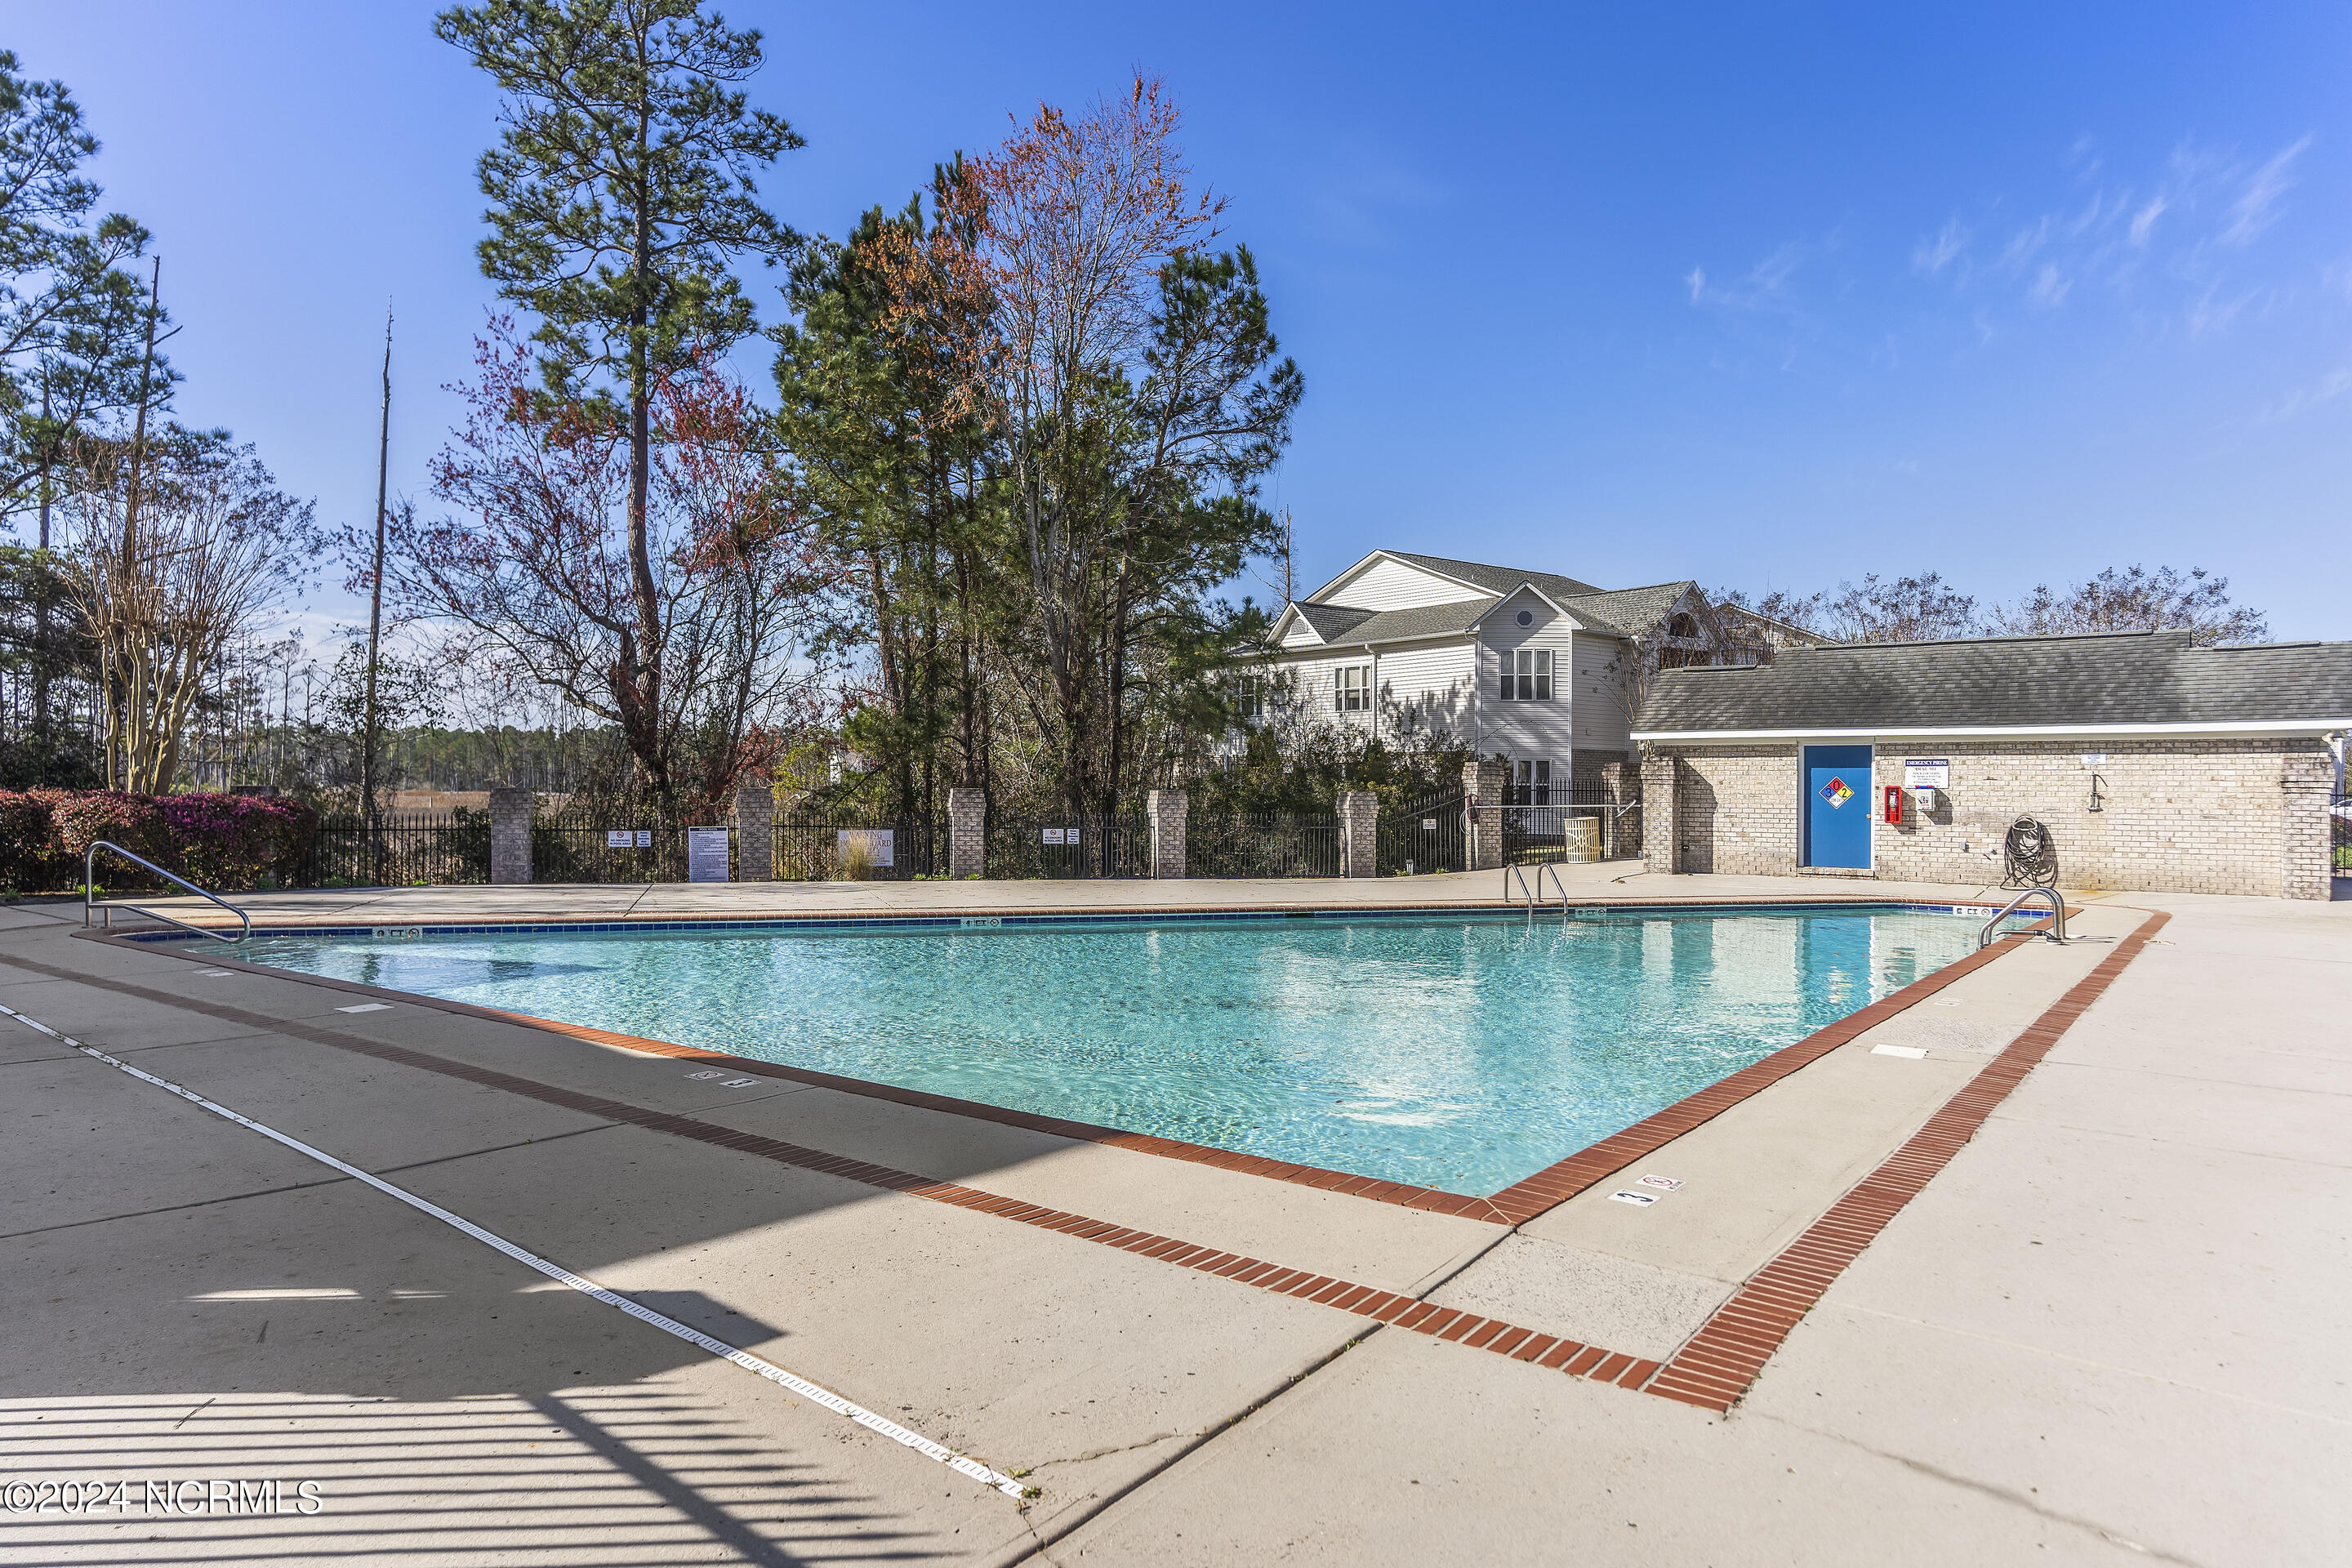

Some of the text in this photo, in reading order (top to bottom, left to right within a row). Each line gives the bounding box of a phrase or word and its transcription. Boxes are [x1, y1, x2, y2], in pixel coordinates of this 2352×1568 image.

[1833, 780, 1840, 791] 0
[1825, 787, 1832, 798] 3
[1842, 787, 1847, 798] 2
